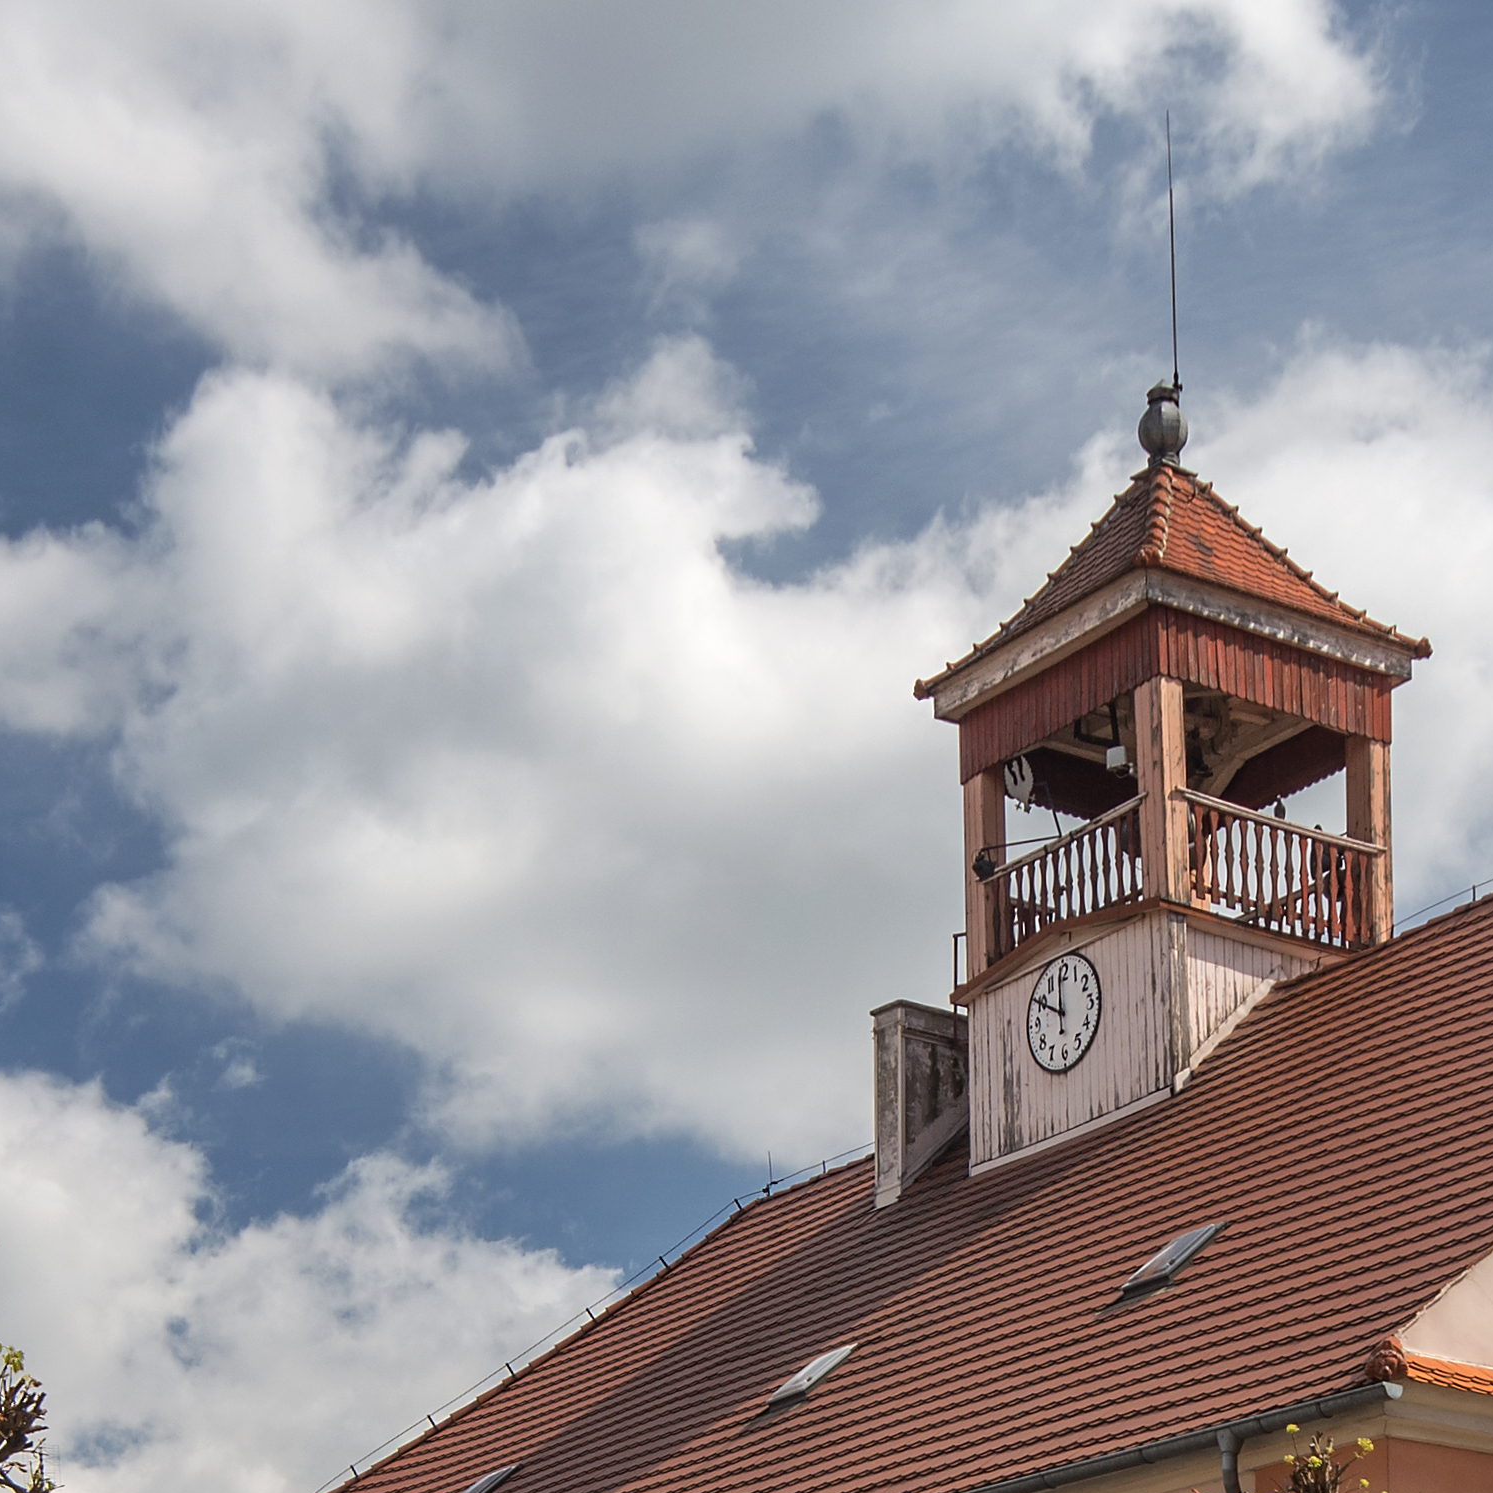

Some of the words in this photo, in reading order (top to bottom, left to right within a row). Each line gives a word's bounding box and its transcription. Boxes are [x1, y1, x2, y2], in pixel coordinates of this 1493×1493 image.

[1073, 965, 1078, 982] 1
[1047, 975, 1055, 994] 11
[1080, 974, 1089, 992] 2
[1086, 993, 1095, 1010] 3
[1034, 1016, 1041, 1034] 9
[1082, 1013, 1090, 1031] 4
[1039, 1033, 1047, 1051] 8
[1073, 1032, 1082, 1051] 5
[1048, 1044, 1055, 1061] 7
[1061, 1043, 1068, 1061] 6
